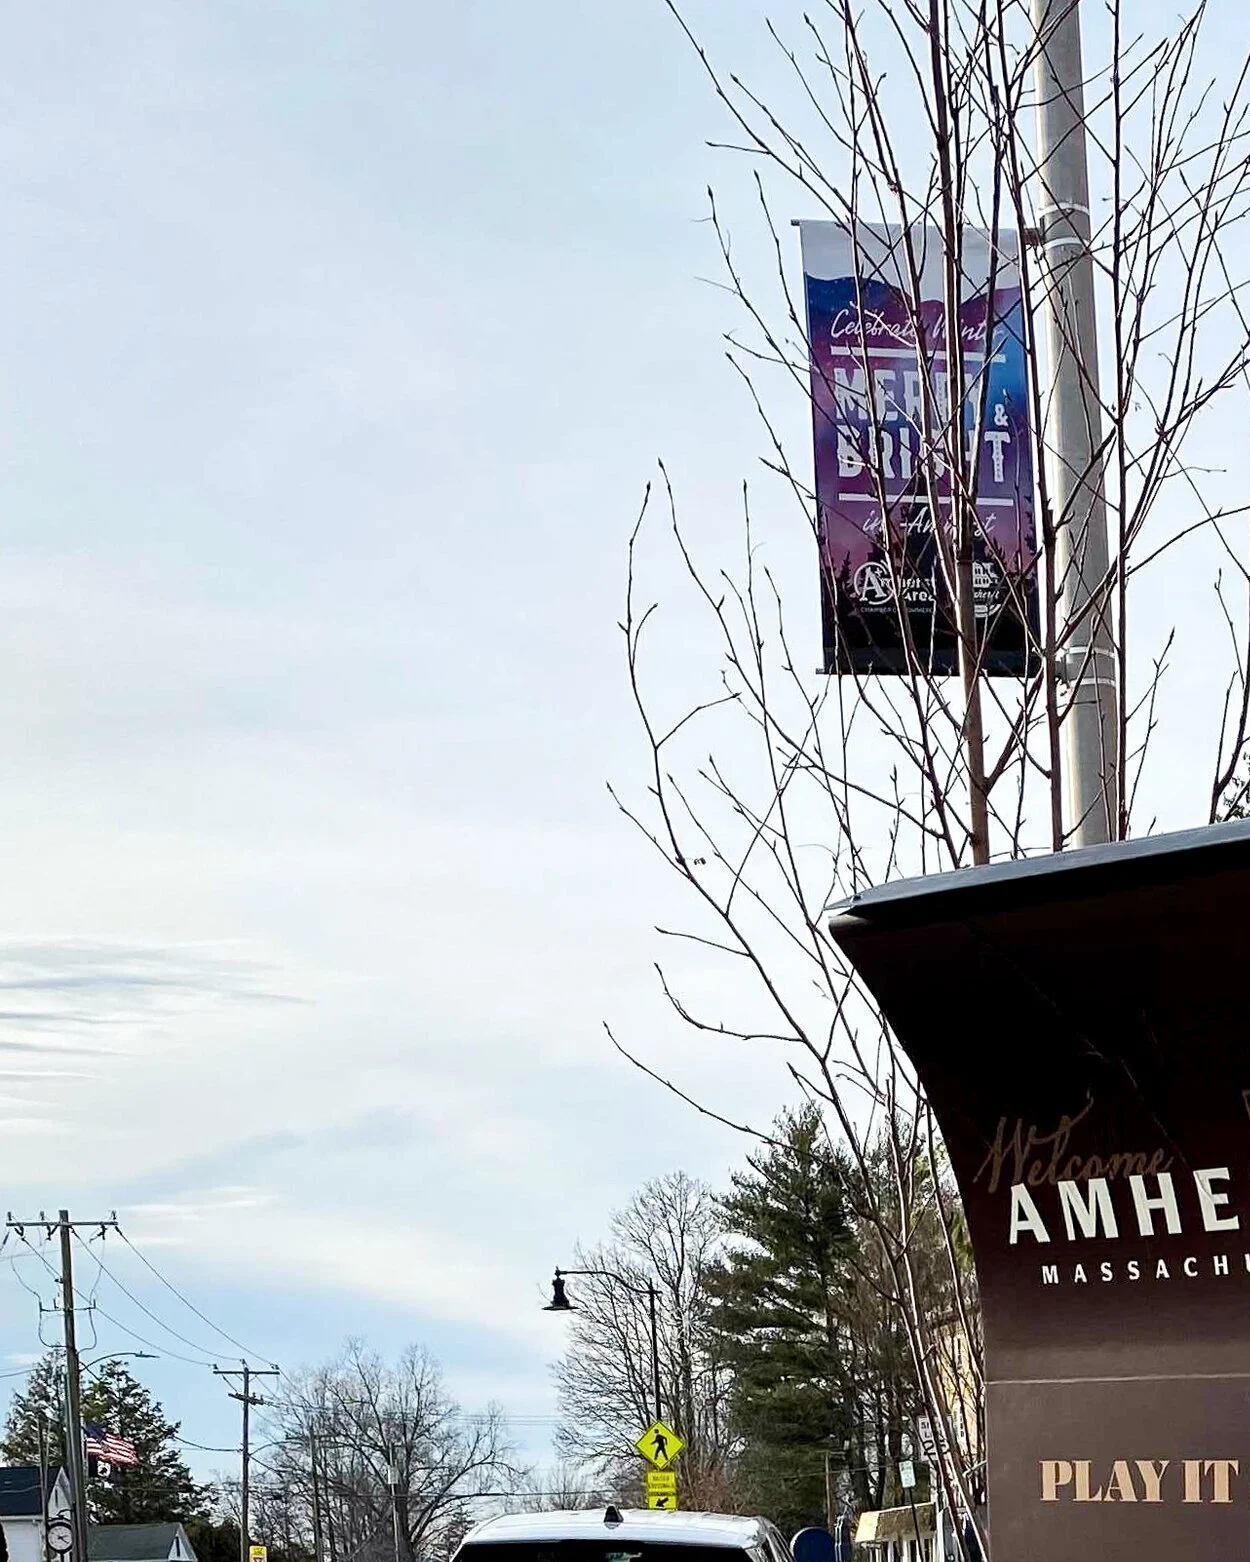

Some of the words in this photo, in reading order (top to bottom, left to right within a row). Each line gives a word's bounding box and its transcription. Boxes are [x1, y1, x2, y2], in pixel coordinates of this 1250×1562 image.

[994, 403, 1008, 426] &
[973, 1098, 1175, 1193] Welcome
[1039, 1459, 1170, 1503] PLAY
[1181, 1459, 1240, 1504] IT
